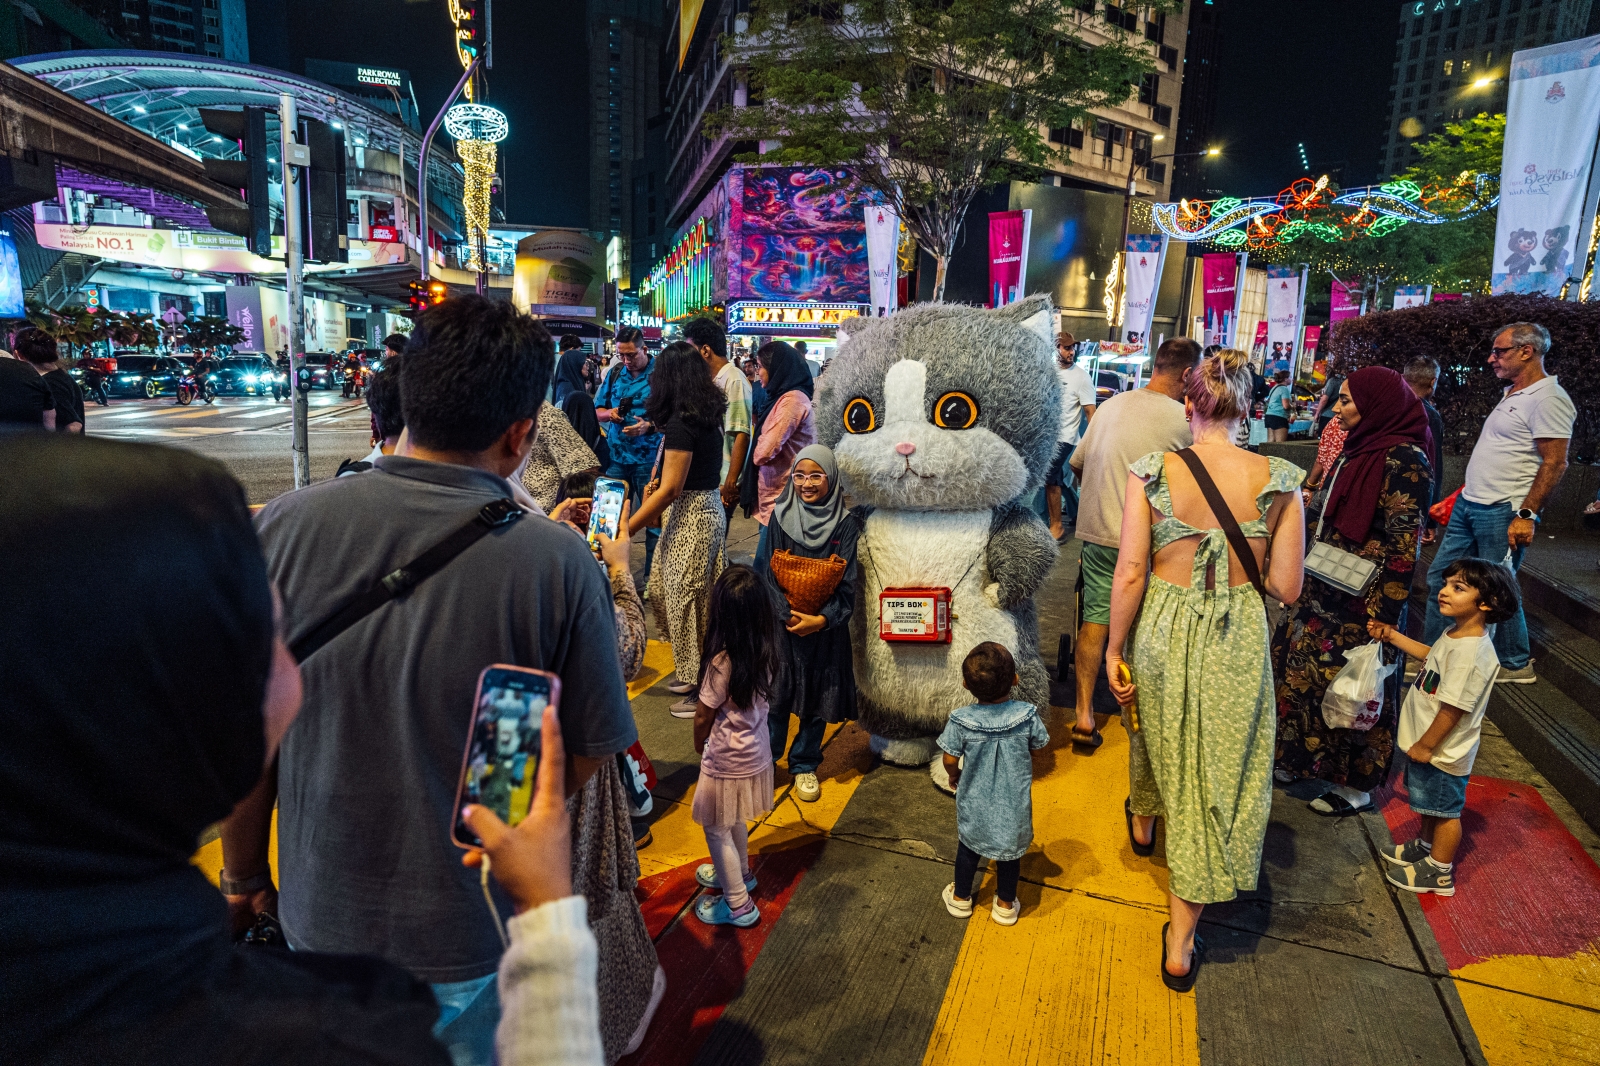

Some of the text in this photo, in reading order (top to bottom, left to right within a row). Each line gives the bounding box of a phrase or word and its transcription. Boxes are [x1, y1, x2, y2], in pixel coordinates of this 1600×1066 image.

[357, 67, 401, 80] PARKROYAL
[357, 75, 401, 87] COLLECTION
[61, 240, 95, 249] Malaysia
[196, 236, 217, 244] Bukit
[532, 244, 561, 253] Mudah
[545, 290, 579, 299] TIGER
[743, 307, 780, 323] HOT
